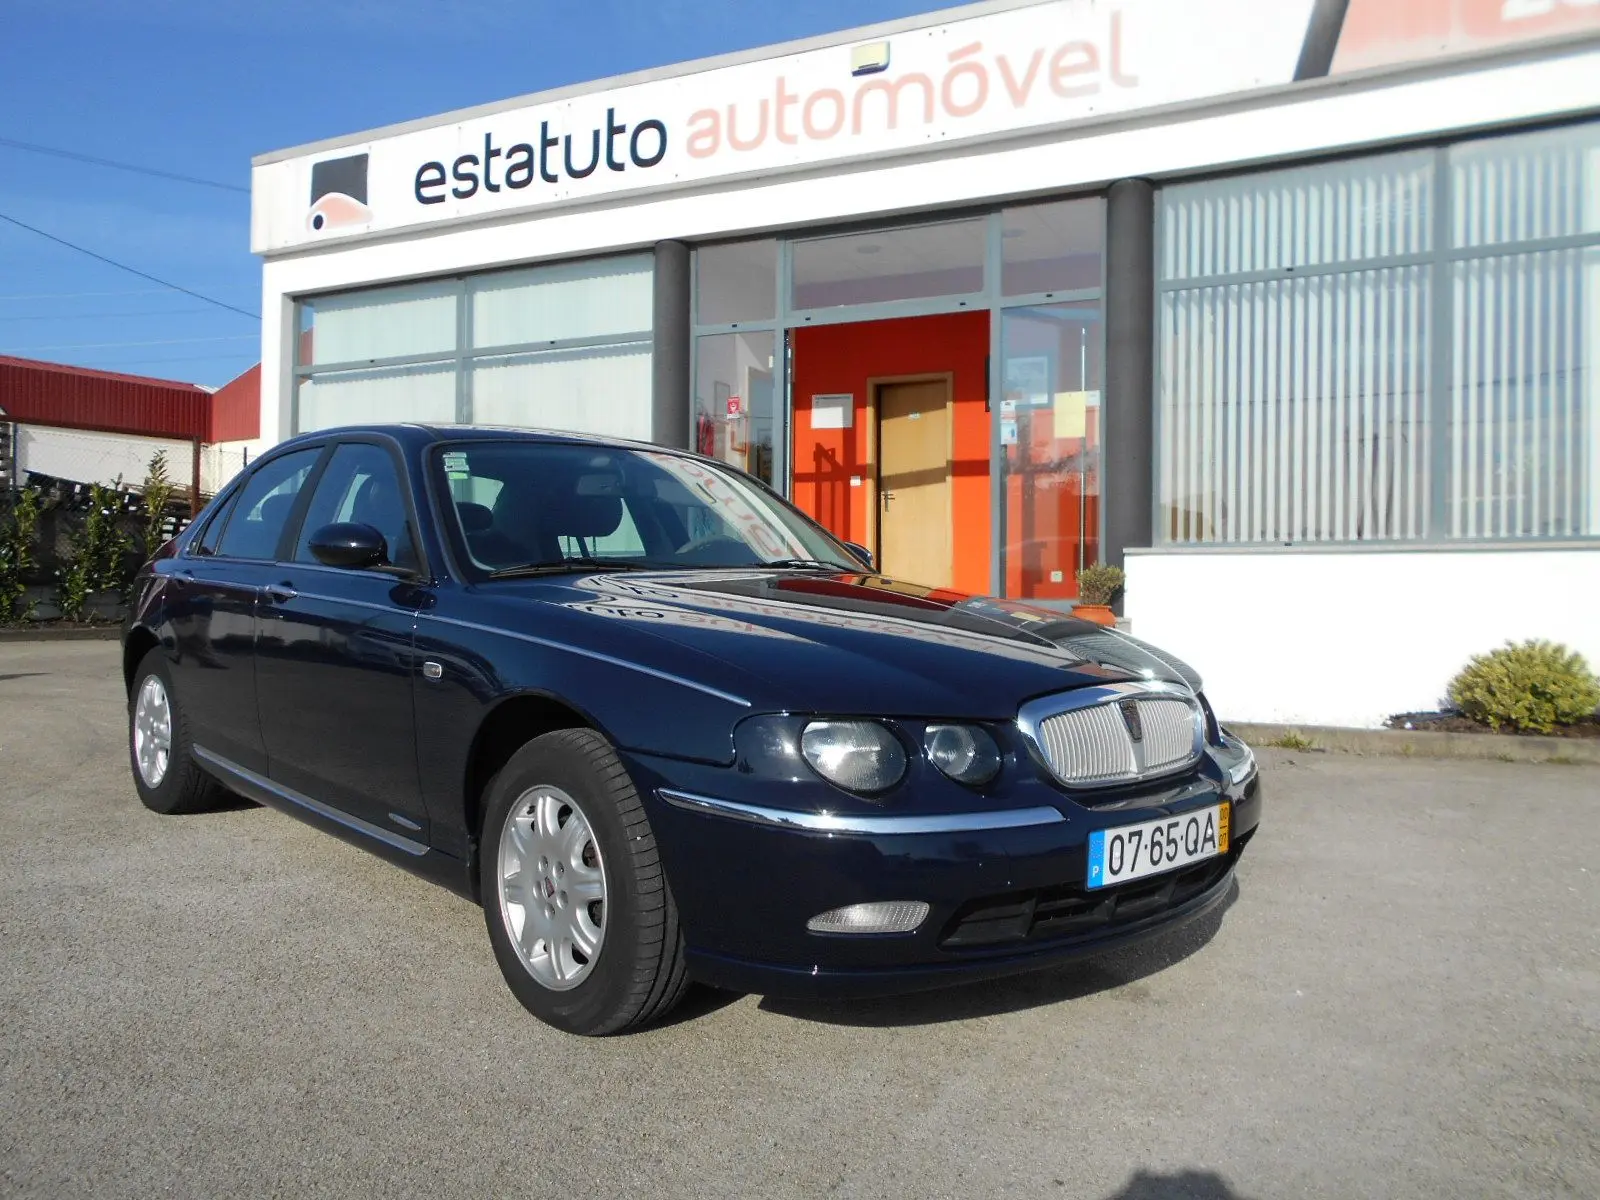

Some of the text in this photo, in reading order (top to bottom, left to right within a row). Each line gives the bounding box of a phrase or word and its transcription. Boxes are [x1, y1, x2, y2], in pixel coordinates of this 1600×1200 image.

[414, 10, 1140, 205] estatuto automóvel
[1092, 865, 1100, 878] P
